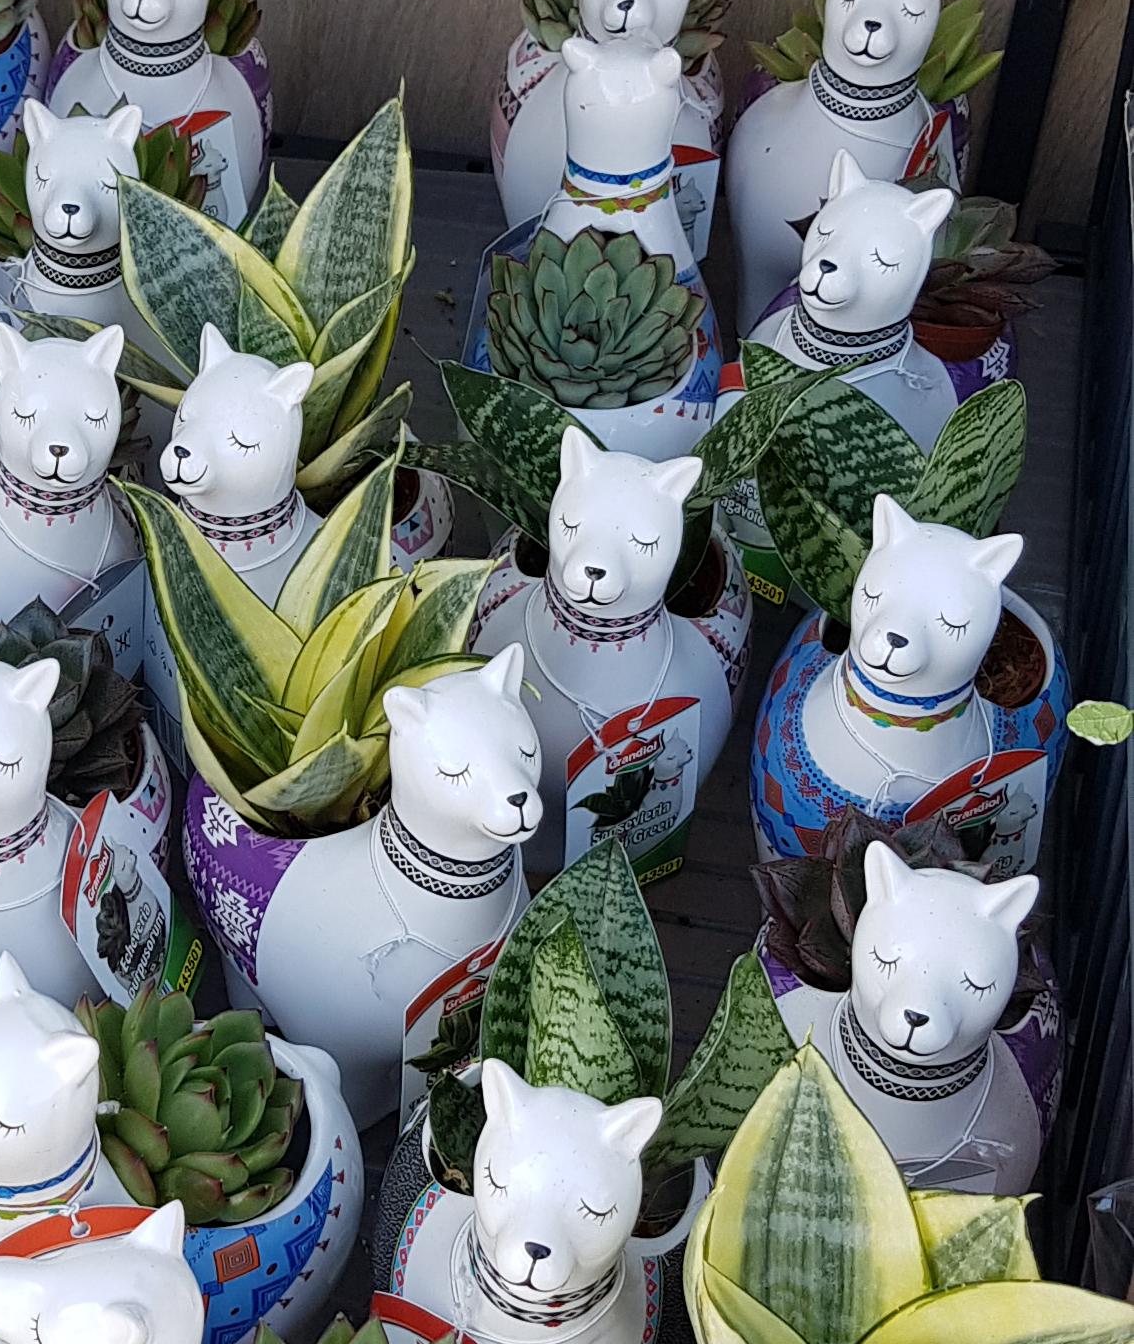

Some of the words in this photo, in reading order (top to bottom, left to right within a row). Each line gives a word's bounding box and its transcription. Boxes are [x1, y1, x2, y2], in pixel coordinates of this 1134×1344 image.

[608, 741, 658, 771] Grandiol
[947, 795, 1001, 824] Grandiol
[87, 850, 109, 902] Grandiol
[120, 902, 152, 973] Echeveria
[445, 982, 487, 1012] Grandi
